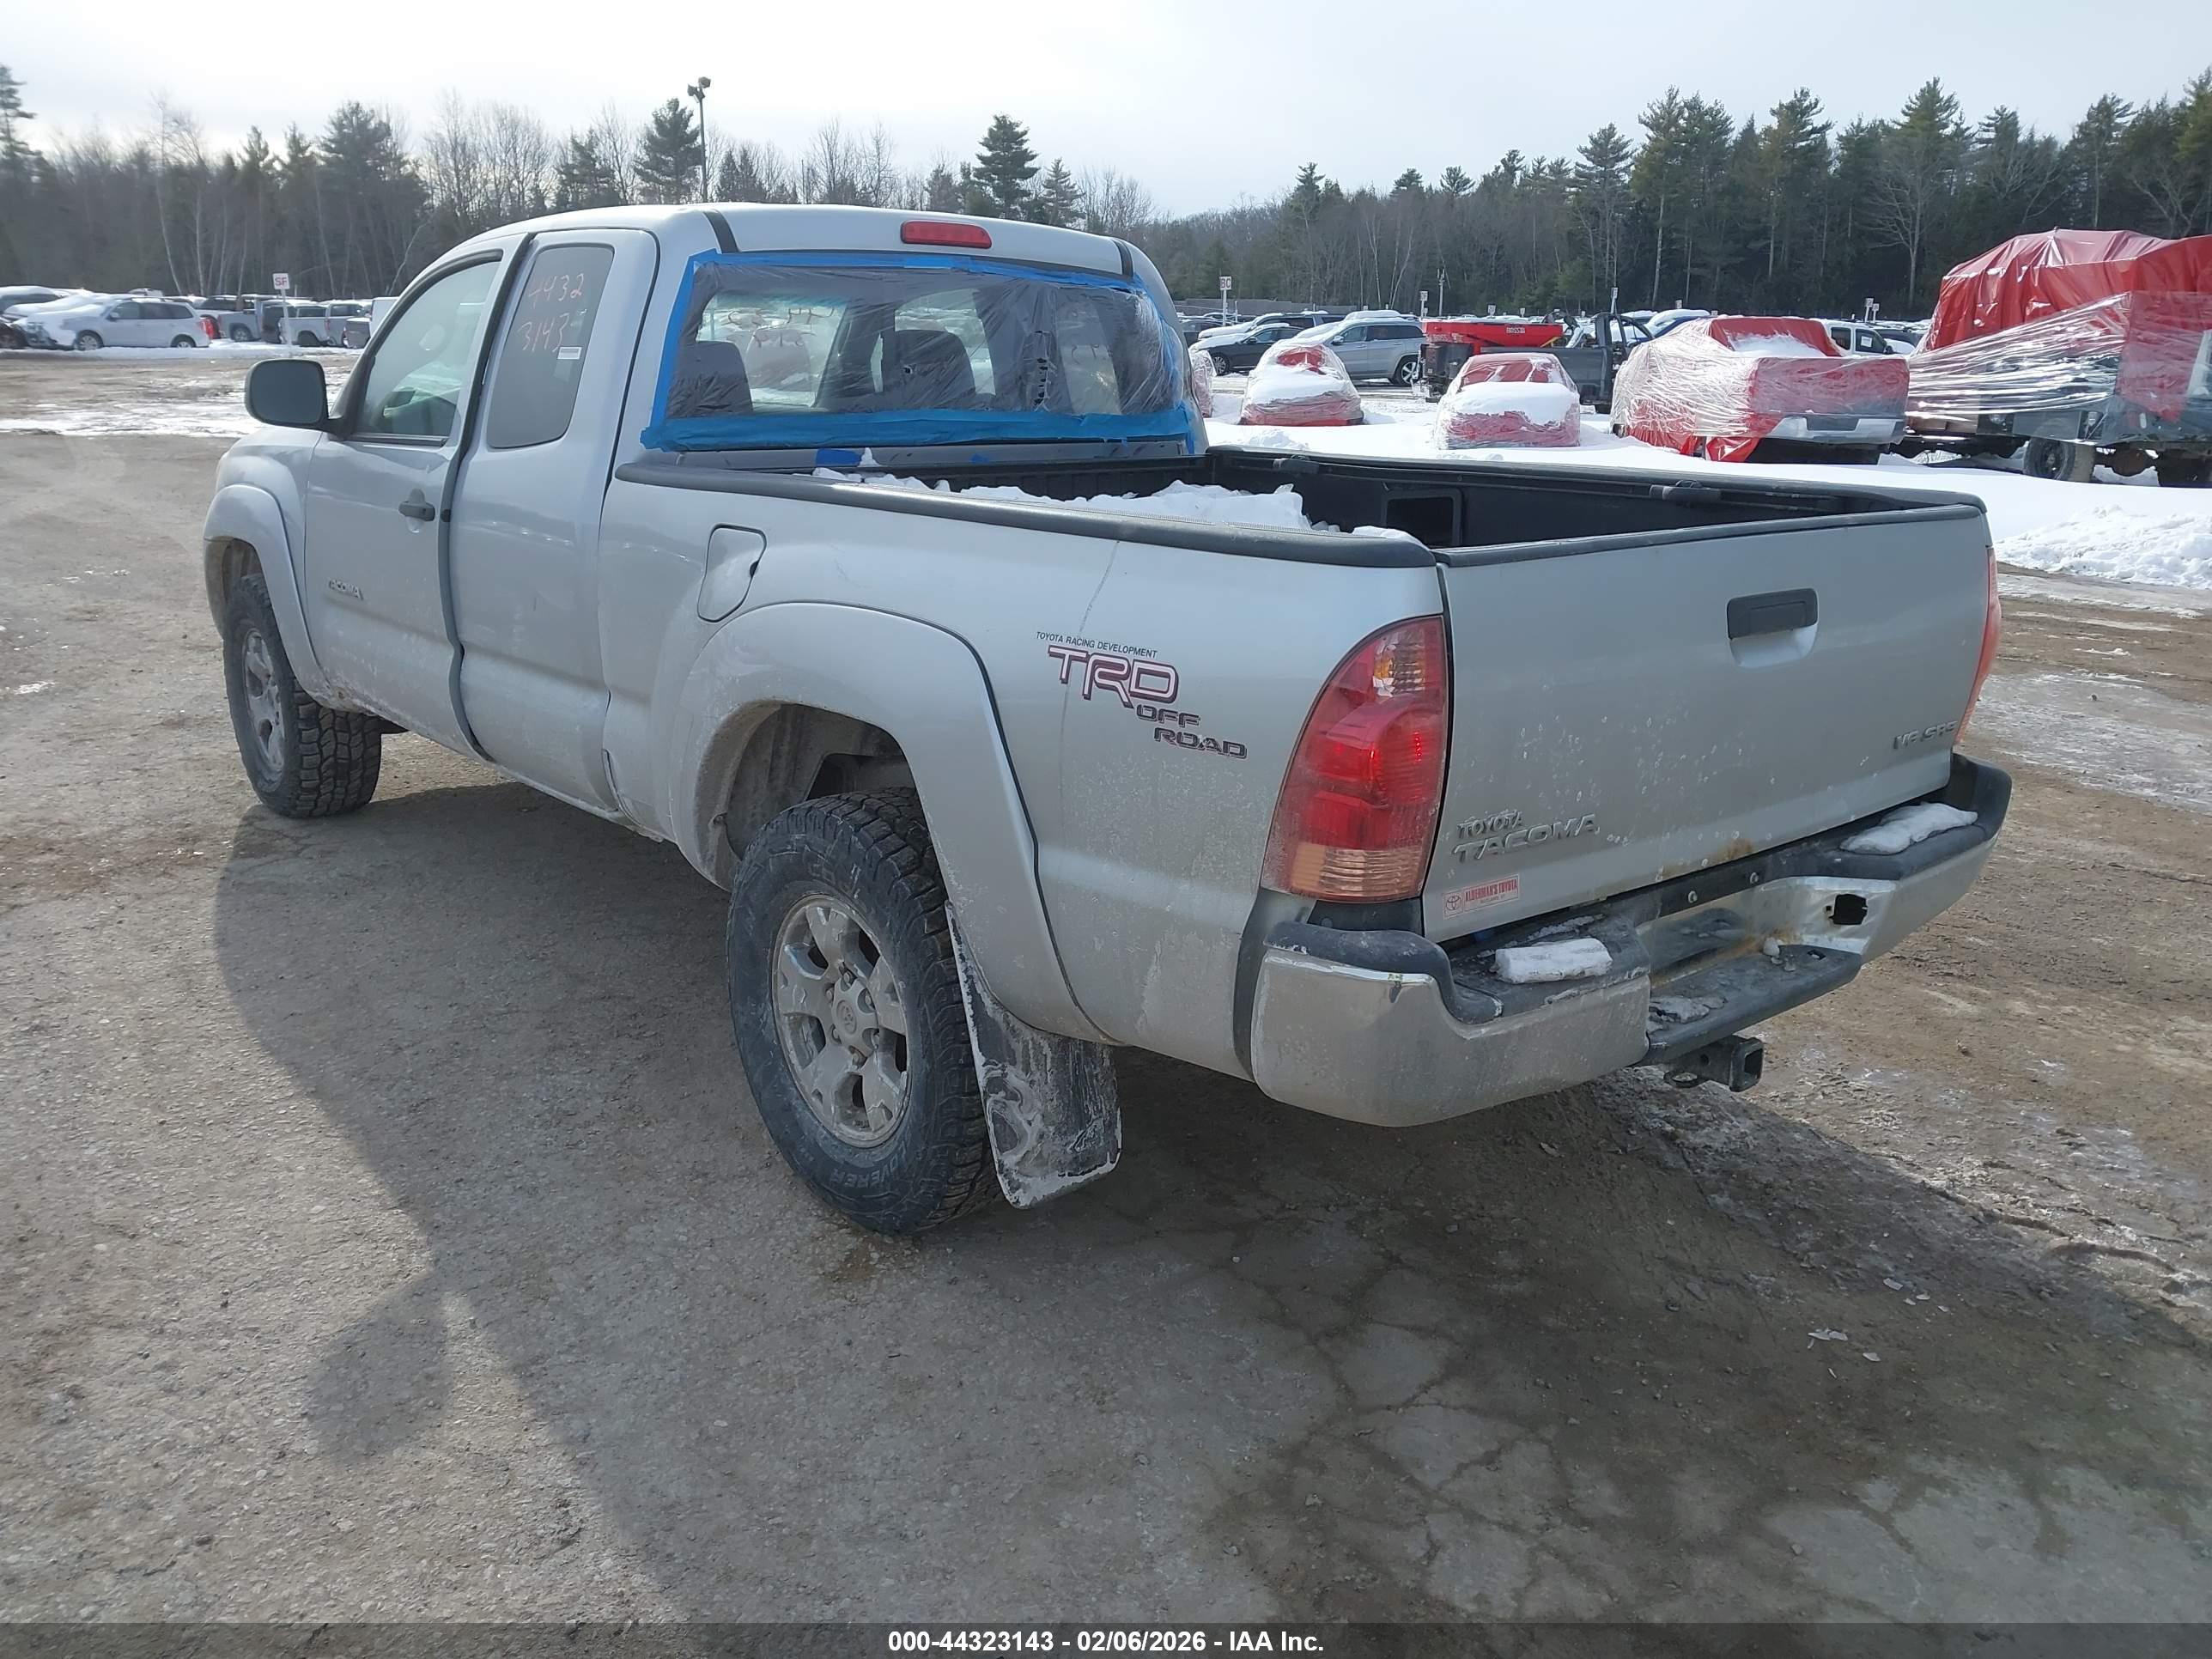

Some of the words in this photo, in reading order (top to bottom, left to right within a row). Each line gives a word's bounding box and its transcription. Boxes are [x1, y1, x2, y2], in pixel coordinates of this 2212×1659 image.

[275, 276, 288, 286] SF
[1219, 277, 1231, 289] BC
[1036, 631, 1064, 643] TOYOTA
[1066, 636, 1096, 648] RACING
[1097, 641, 1158, 659] DEVELOPMENT
[1048, 645, 1180, 708] TRD
[1136, 703, 1200, 728] OFF
[1153, 727, 1248, 759] ROAD
[1451, 813, 1599, 862] TACOMA
[1457, 811, 1523, 839] TOYOTA
[1498, 878, 1518, 894] TOYOTA
